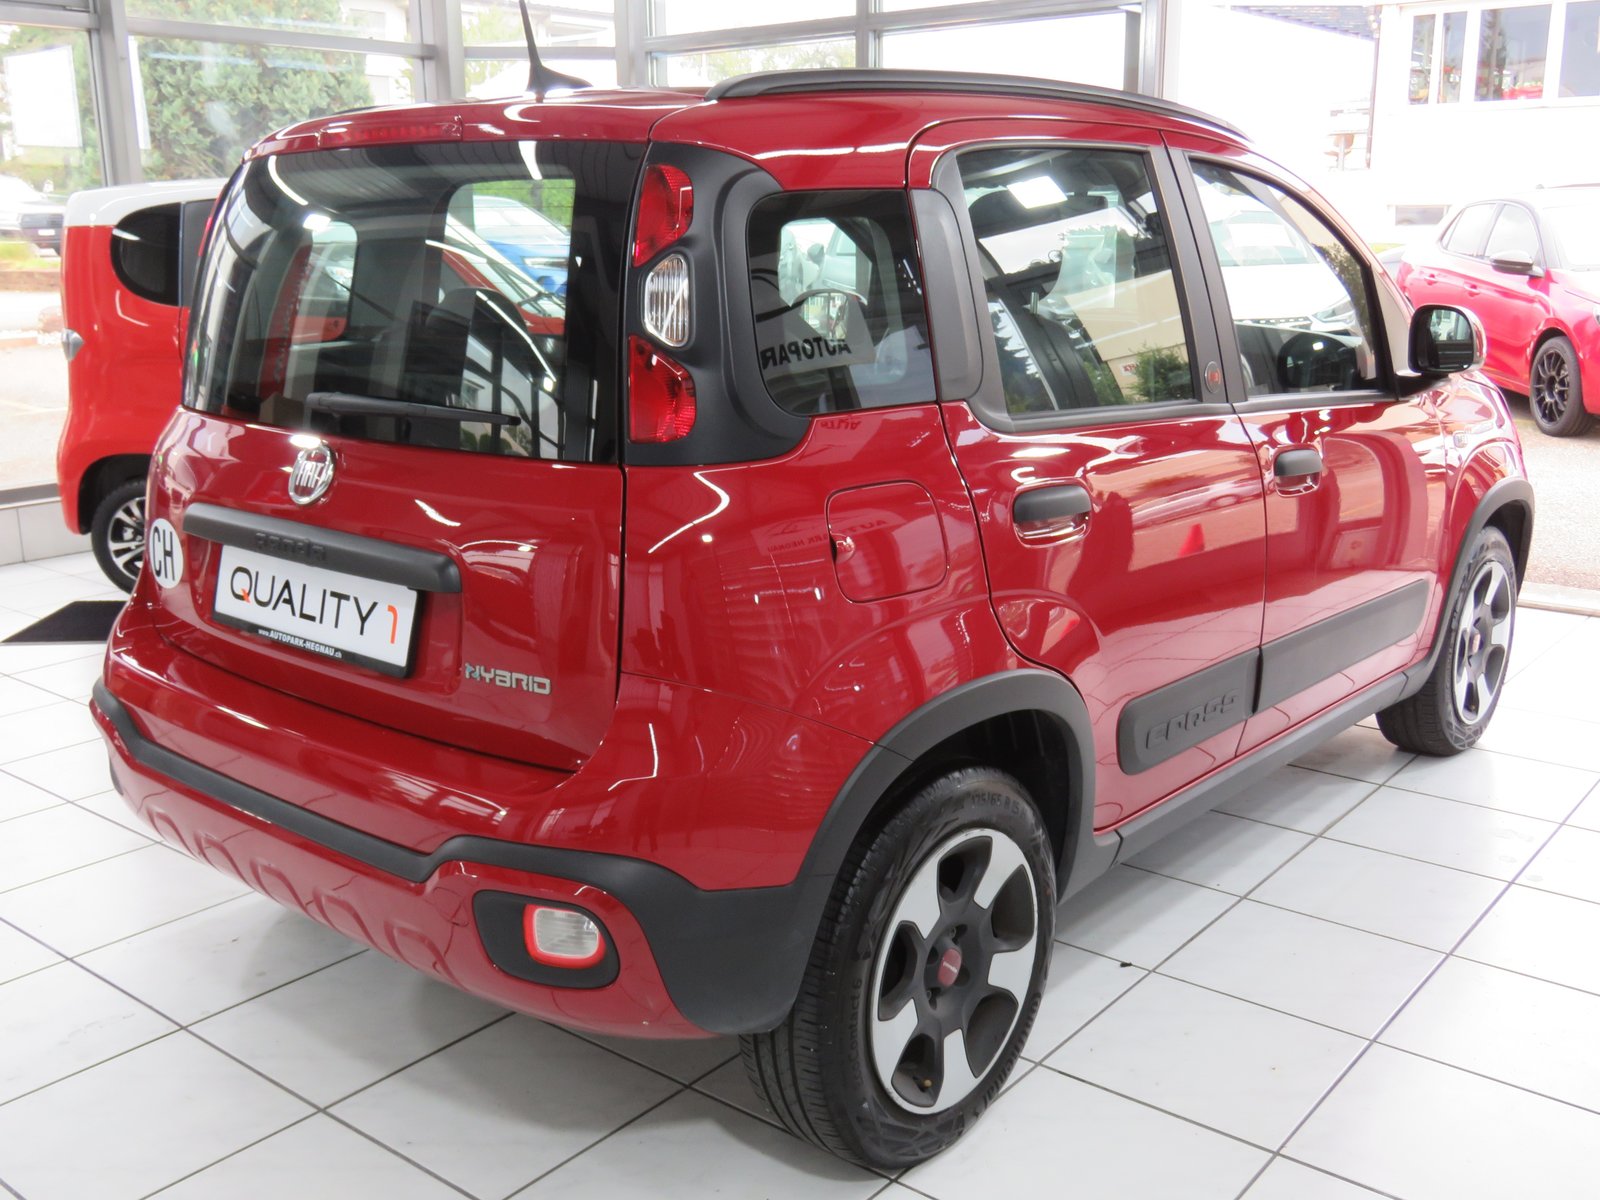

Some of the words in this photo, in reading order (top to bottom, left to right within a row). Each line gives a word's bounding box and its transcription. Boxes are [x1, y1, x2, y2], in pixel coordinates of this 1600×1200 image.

[296, 460, 325, 488] FIAT
[152, 525, 175, 581] CH
[230, 566, 378, 636] QUALITY
[387, 604, 398, 644] 1
[258, 628, 342, 659] www.AUTOPARK-HEGNAU.ch
[465, 662, 551, 695] HYBRID
